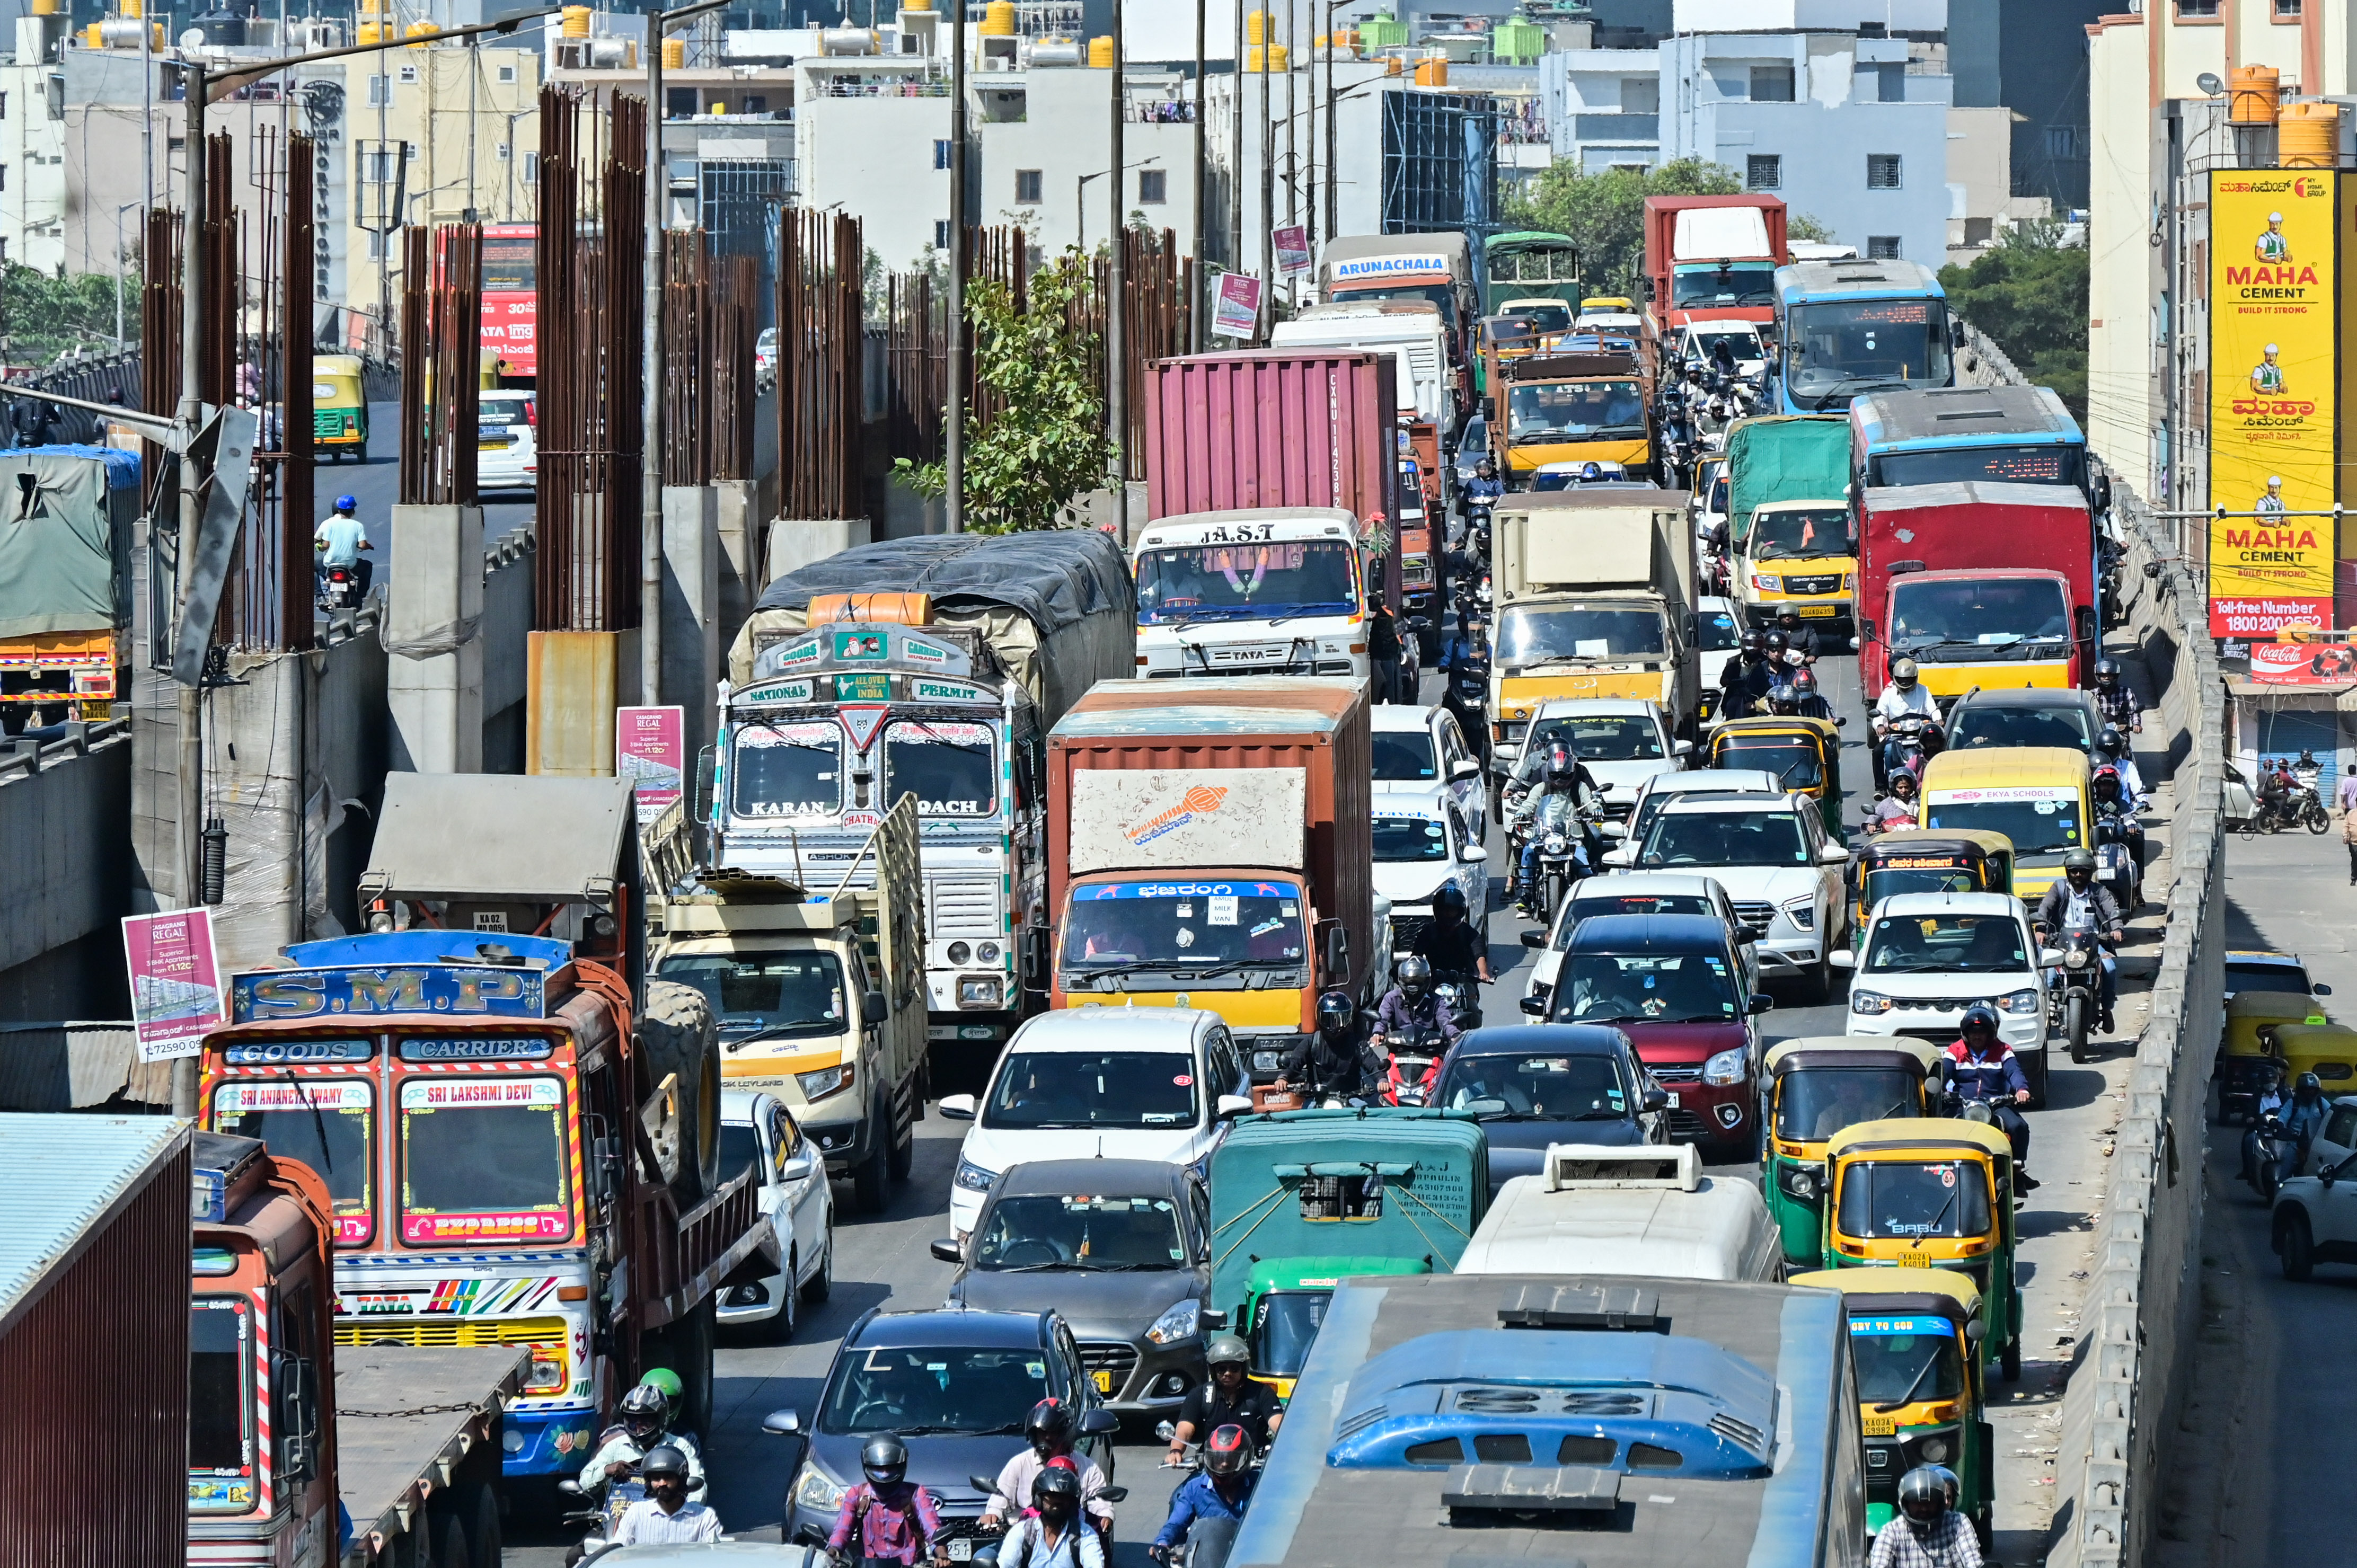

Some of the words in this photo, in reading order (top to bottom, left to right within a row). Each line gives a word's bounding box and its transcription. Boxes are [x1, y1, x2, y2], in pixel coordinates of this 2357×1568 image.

[1339, 259, 1443, 275] ARUNACHALA
[2227, 267, 2319, 285] MAHA
[2241, 288, 2305, 298] CEMENT
[507, 303, 525, 314] 30
[480, 326, 505, 336] ATA
[2232, 396, 2315, 415] ಮಹಾ
[2226, 529, 2318, 548] MAHA
[2240, 552, 2305, 562] CEMENT
[1800, 607, 1835, 615] A04AD4355
[2216, 601, 2262, 614] Toll-free
[2263, 601, 2316, 614] Number
[2227, 616, 2258, 631] 1800
[2259, 616, 2284, 632] 200
[783, 643, 817, 660] GOODS
[907, 641, 943, 657] CARRIER
[2258, 645, 2303, 662] Coca-Cola
[783, 655, 819, 666] MILEGA
[1232, 651, 1265, 660] TATA
[854, 676, 867, 685] ALL
[868, 675, 886, 685] OVER
[857, 688, 884, 698] INDIA
[919, 684, 976, 699] PERMIT
[751, 801, 825, 815] KARAN
[917, 800, 978, 813] OACH
[1888, 858, 1912, 867] ದೇವರ
[1138, 883, 1232, 897] ಭಜರಂಗಿ
[480, 914, 490, 923] KA
[491, 914, 500, 923] 02
[152, 927, 186, 940] REGAL
[490, 924, 505, 933] 0051
[159, 950, 184, 958] Superior
[164, 953, 198, 964] Apartments
[186, 1022, 217, 1032] CASAGRAND
[153, 1042, 186, 1053] 72590
[242, 1042, 348, 1061] GOODS
[420, 1039, 529, 1057] CARRIER
[241, 1091, 258, 1105] SRI
[260, 1089, 306, 1104] ANJANEYA
[307, 1088, 342, 1104] SWAMY
[427, 1088, 449, 1103] SRI
[451, 1086, 501, 1101] LAKSHMI
[506, 1084, 532, 1100] DEVI
[1414, 1160, 1424, 1171] A
[1439, 1161, 1449, 1172] J
[1416, 1173, 1461, 1182] RPAULIN
[434, 1217, 537, 1235] EXPRESS
[1892, 1224, 1942, 1234] BABU
[356, 1296, 413, 1312] TATA
[1851, 1322, 1874, 1331] ORY
[1875, 1322, 1888, 1331] TO
[1894, 1321, 1913, 1330] GOD
